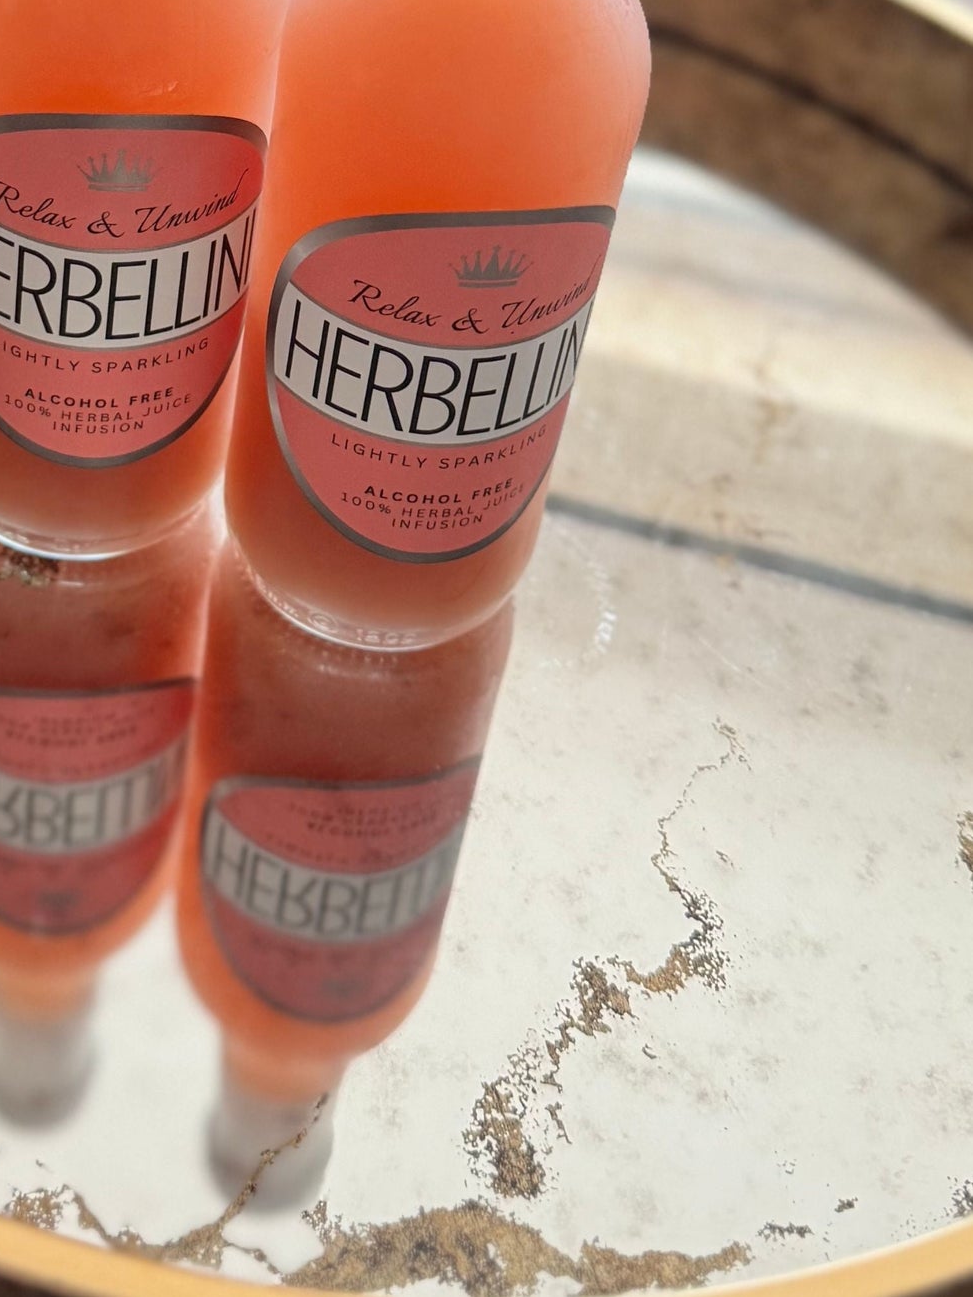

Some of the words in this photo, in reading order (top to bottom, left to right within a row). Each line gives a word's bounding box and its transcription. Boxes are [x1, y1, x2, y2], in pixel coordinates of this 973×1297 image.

[87, 211, 125, 238] &
[135, 168, 249, 234] Unwind
[348, 279, 442, 327] Relax
[451, 308, 490, 334] &
[501, 254, 602, 329] Unwind
[91, 337, 209, 374] SPARKLING
[4, 394, 51, 417] 100%
[61, 410, 133, 422] HERBAL
[143, 393, 192, 417] JUICE
[24, 388, 119, 409] ALCOHOL
[129, 387, 174, 406] FREE
[53, 420, 144, 434] INFUSION
[331, 433, 427, 469] LIGHTLY
[438, 424, 547, 469] SPARKLING
[340, 492, 391, 514] 100%
[402, 505, 474, 518] HERBAL
[483, 484, 525, 510] JUICE
[364, 485, 461, 504] ALCOHOL
[472, 477, 513, 500] FREE
[392, 514, 483, 530] INFUSION
